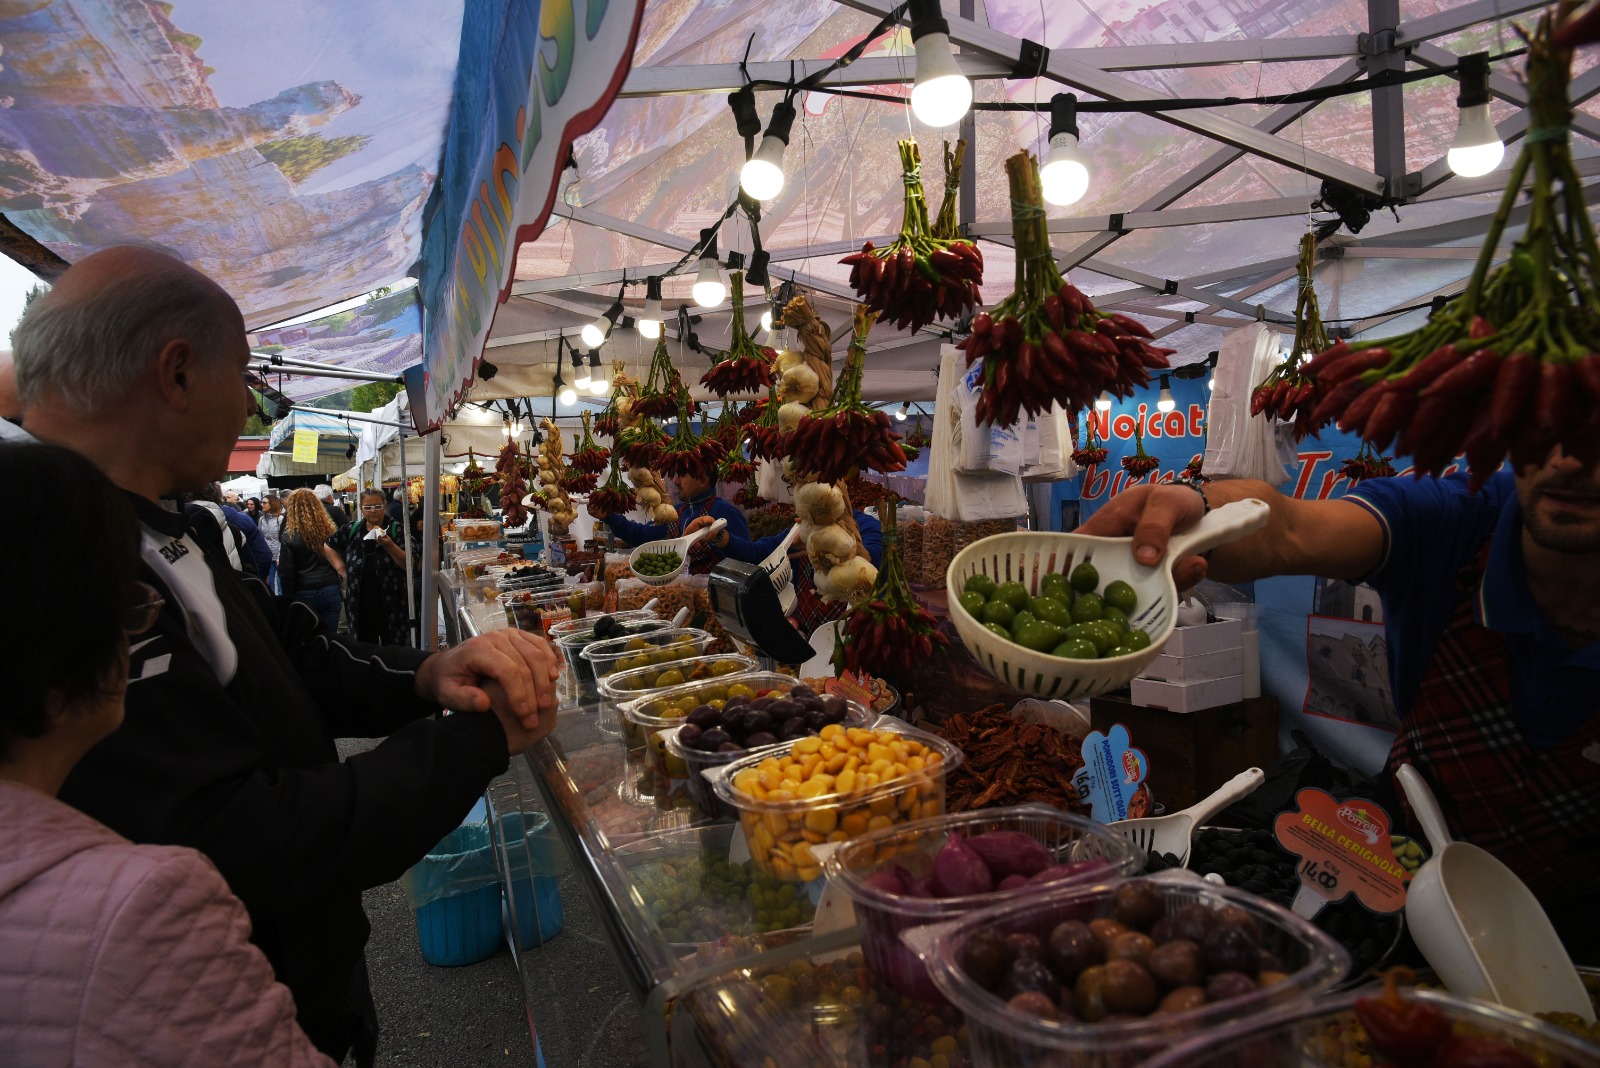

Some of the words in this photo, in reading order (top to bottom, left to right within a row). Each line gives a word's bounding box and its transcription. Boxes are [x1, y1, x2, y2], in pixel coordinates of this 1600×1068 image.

[1088, 403, 1208, 442] Noicat
[1102, 739, 1117, 779] POMODORI
[1340, 808, 1380, 835] Porrelli
[1302, 814, 1337, 840] BELLA
[1336, 834, 1405, 880] CERIGNOLA
